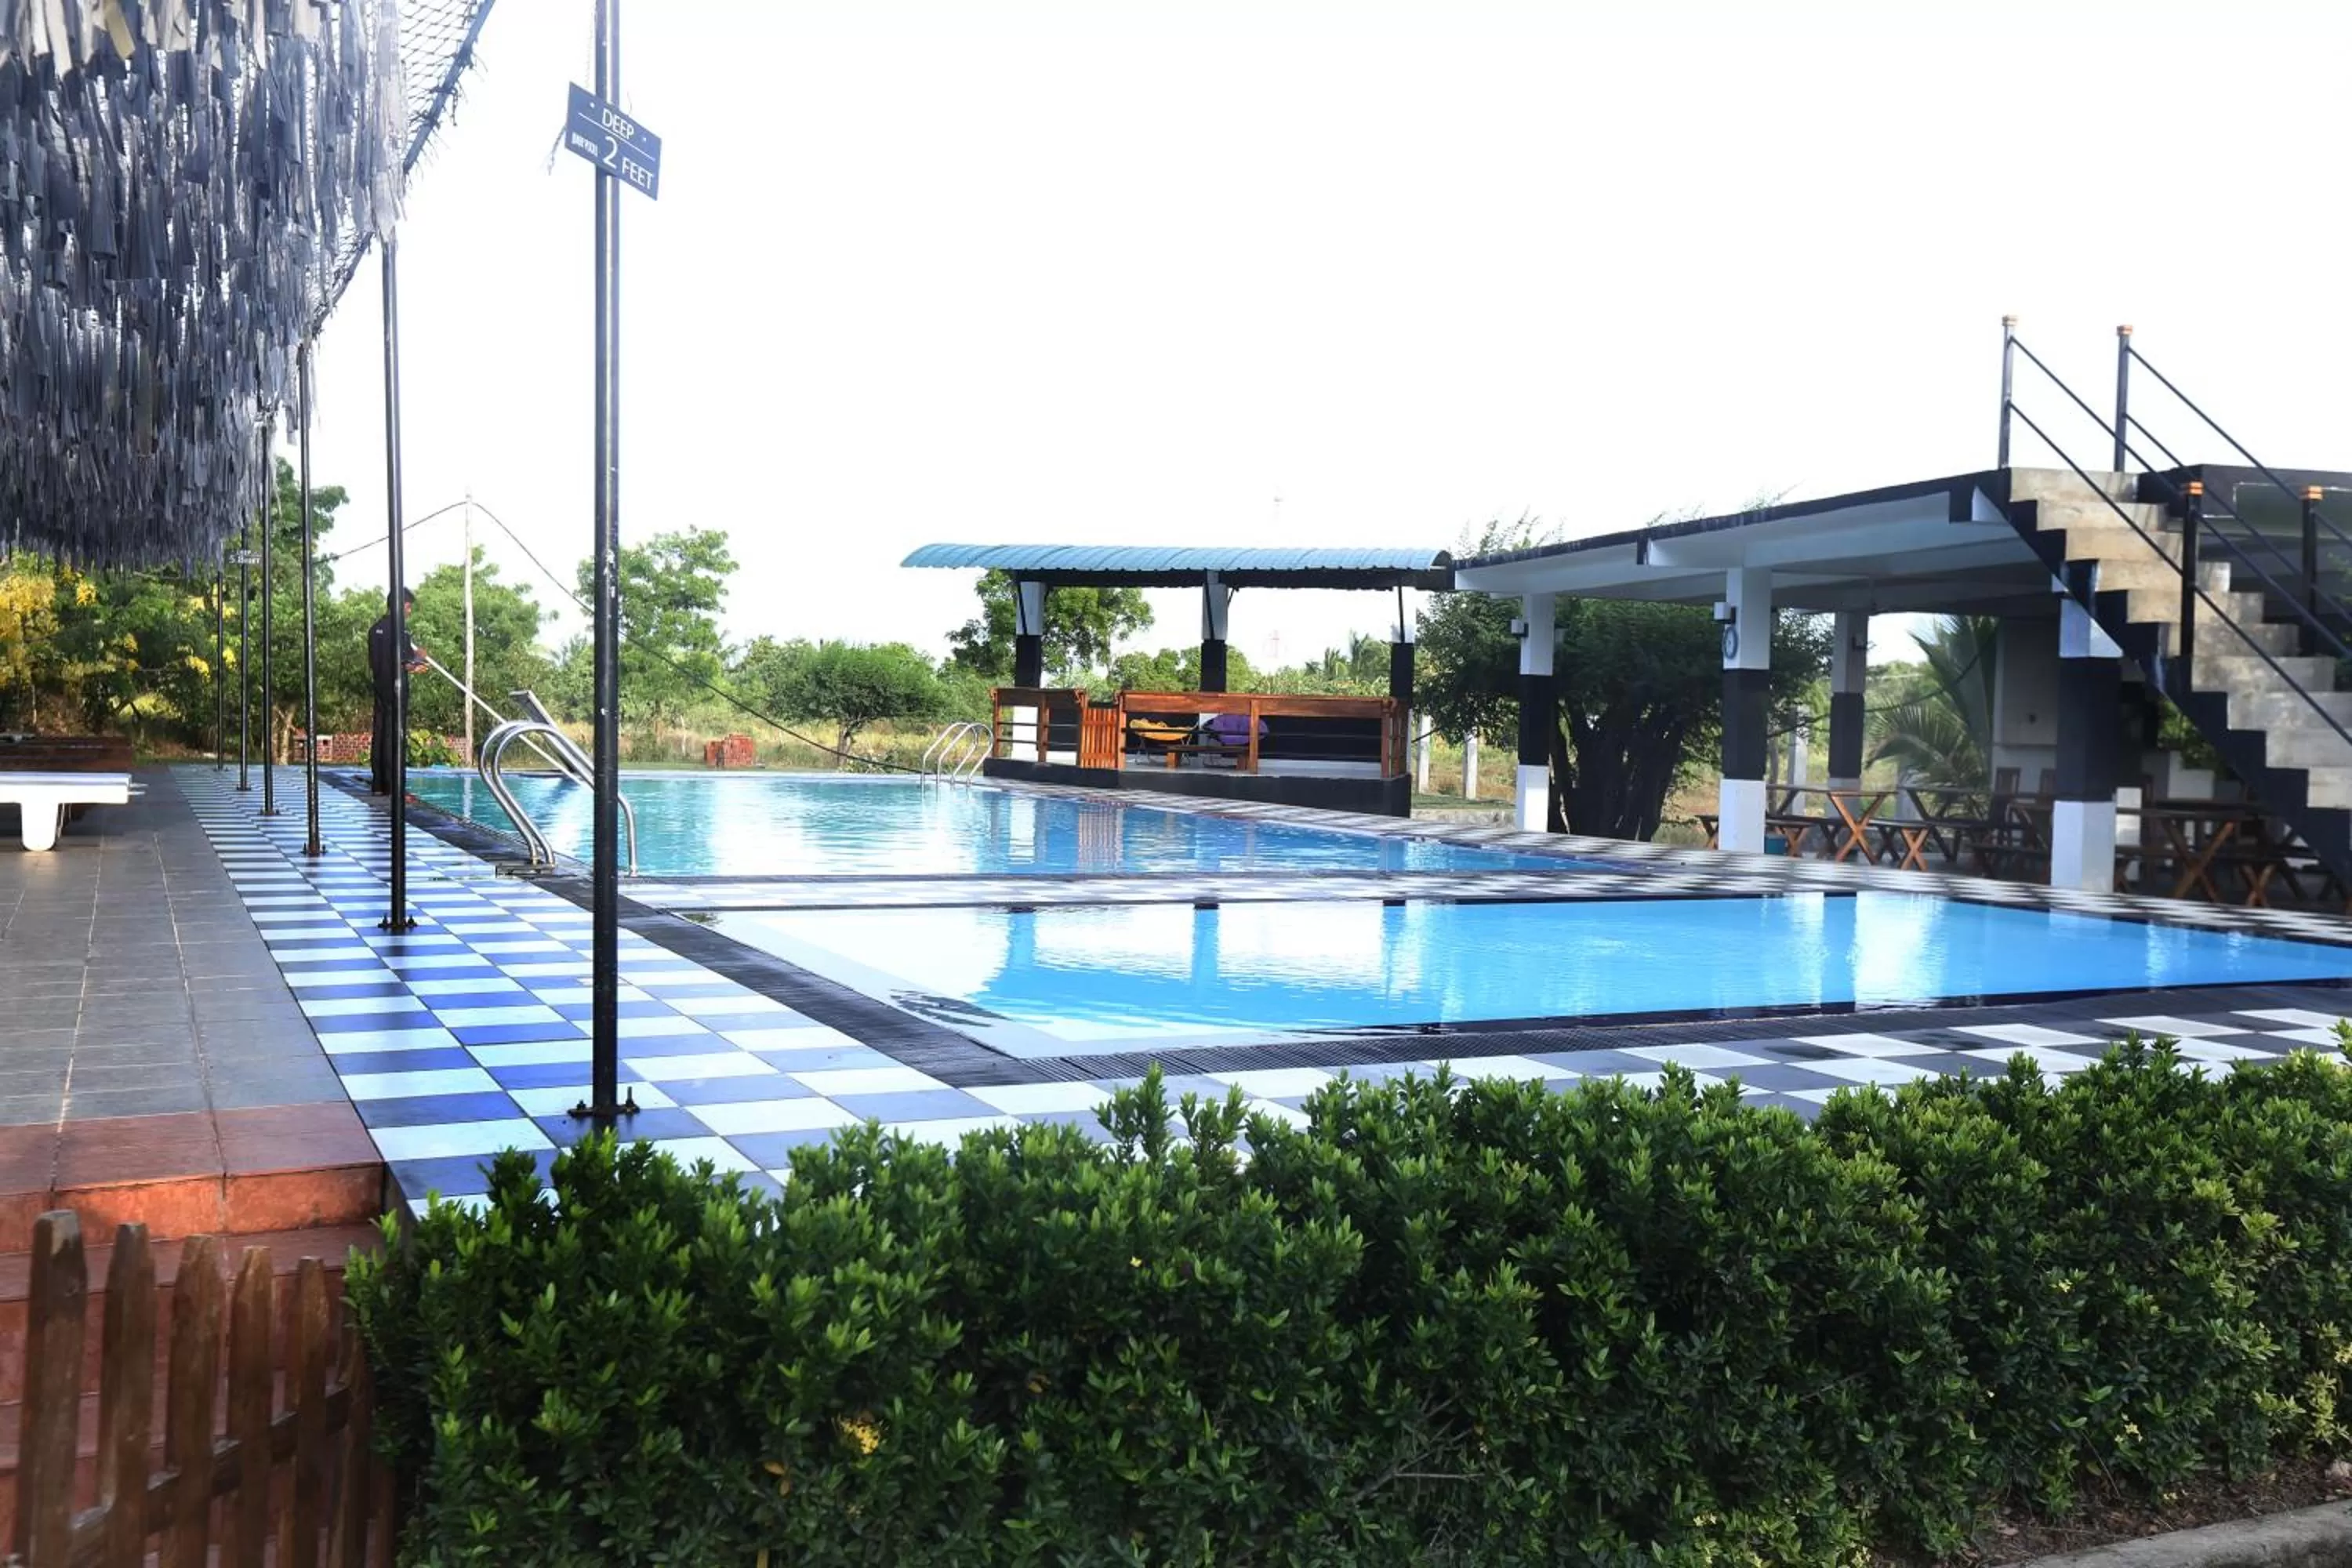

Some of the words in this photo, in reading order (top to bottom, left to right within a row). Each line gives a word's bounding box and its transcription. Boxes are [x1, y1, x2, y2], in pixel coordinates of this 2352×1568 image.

[602, 107, 634, 140] DEEP
[602, 136, 618, 169] 2
[622, 156, 655, 190] FEET
